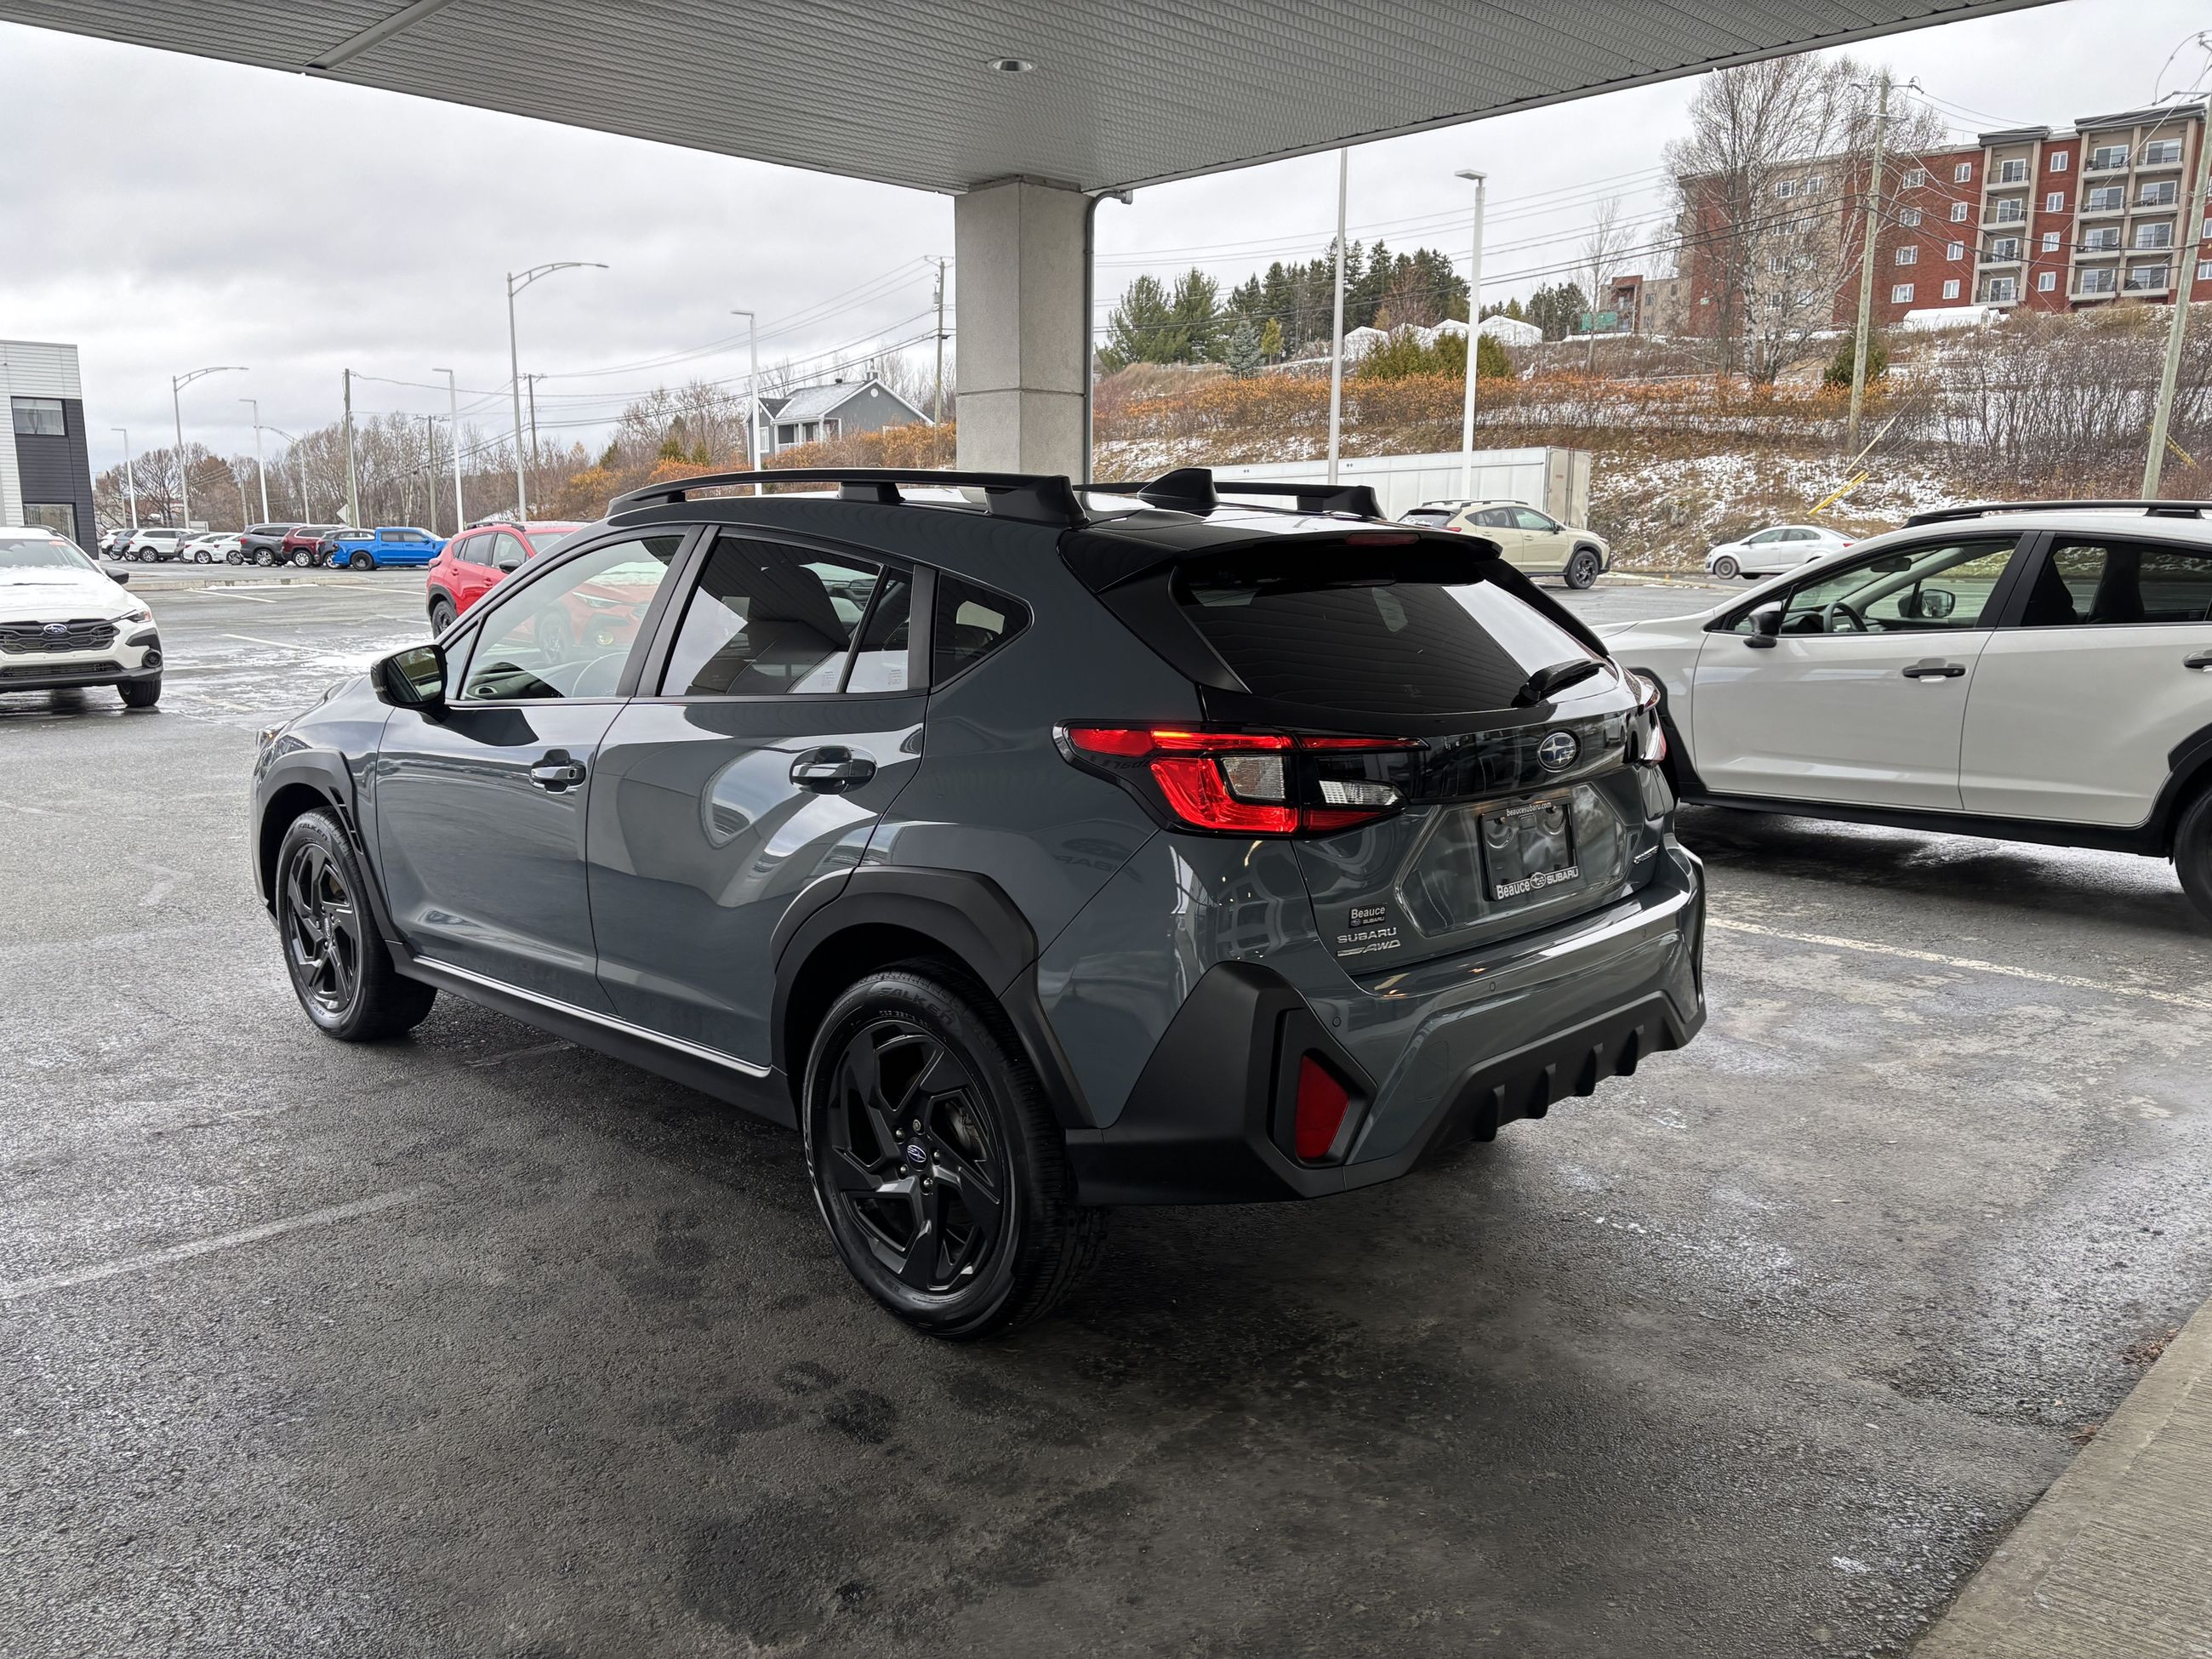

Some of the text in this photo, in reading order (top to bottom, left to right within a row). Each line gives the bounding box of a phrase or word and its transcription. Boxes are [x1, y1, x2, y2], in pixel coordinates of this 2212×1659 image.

[1506, 802, 1552, 817] beaucesubaru.com
[1497, 868, 1579, 900] Beauce SUBARU
[1351, 907, 1386, 920] Beauce
[1337, 926, 1397, 944] SUBARU
[1362, 939, 1401, 954] AWD
